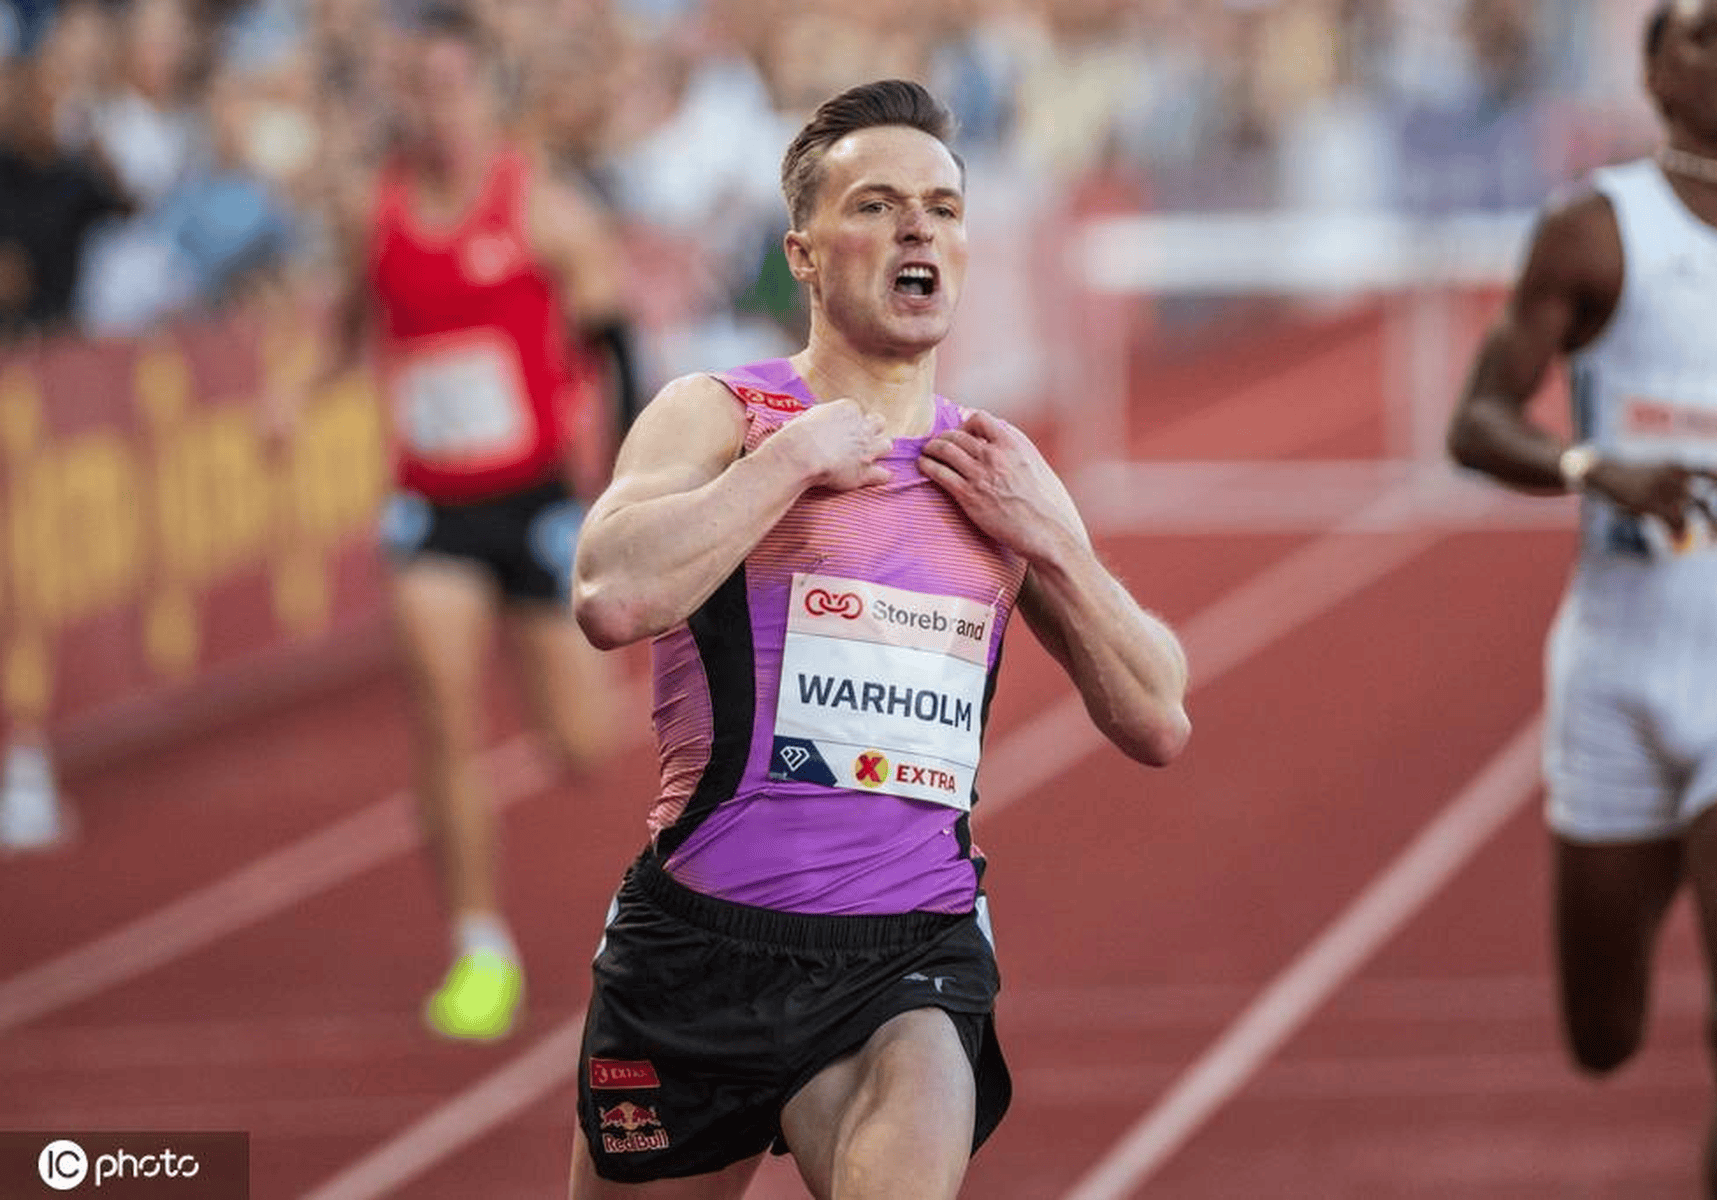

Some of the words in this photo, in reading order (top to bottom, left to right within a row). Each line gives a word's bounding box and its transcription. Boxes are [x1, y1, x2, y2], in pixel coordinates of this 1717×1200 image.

[872, 599, 985, 641] Storeband
[798, 673, 973, 732] WARHOLM
[896, 764, 956, 793] EXTRA
